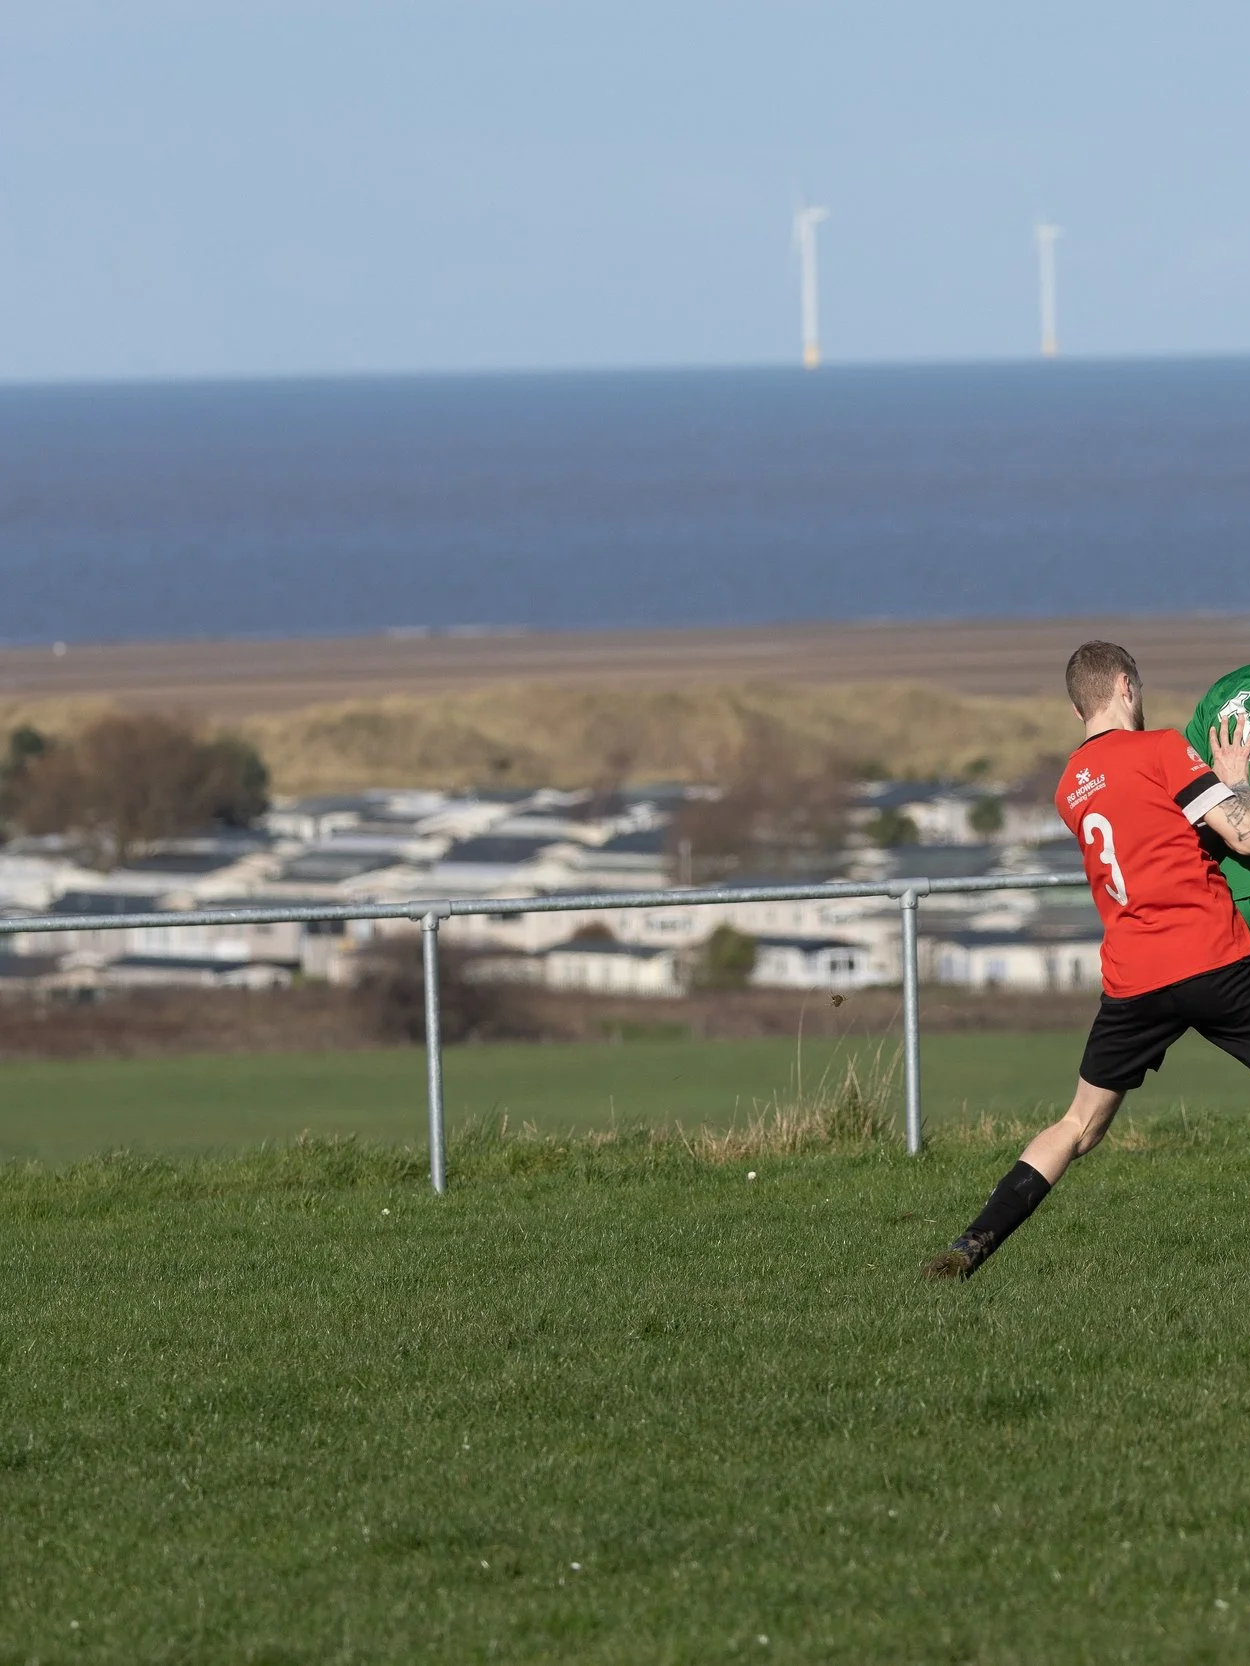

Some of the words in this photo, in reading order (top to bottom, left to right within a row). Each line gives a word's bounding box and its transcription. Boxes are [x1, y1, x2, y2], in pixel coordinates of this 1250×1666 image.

[1067, 792, 1076, 804] RG
[1076, 774, 1105, 797] HOWELLS
[1083, 813, 1128, 906] 3
